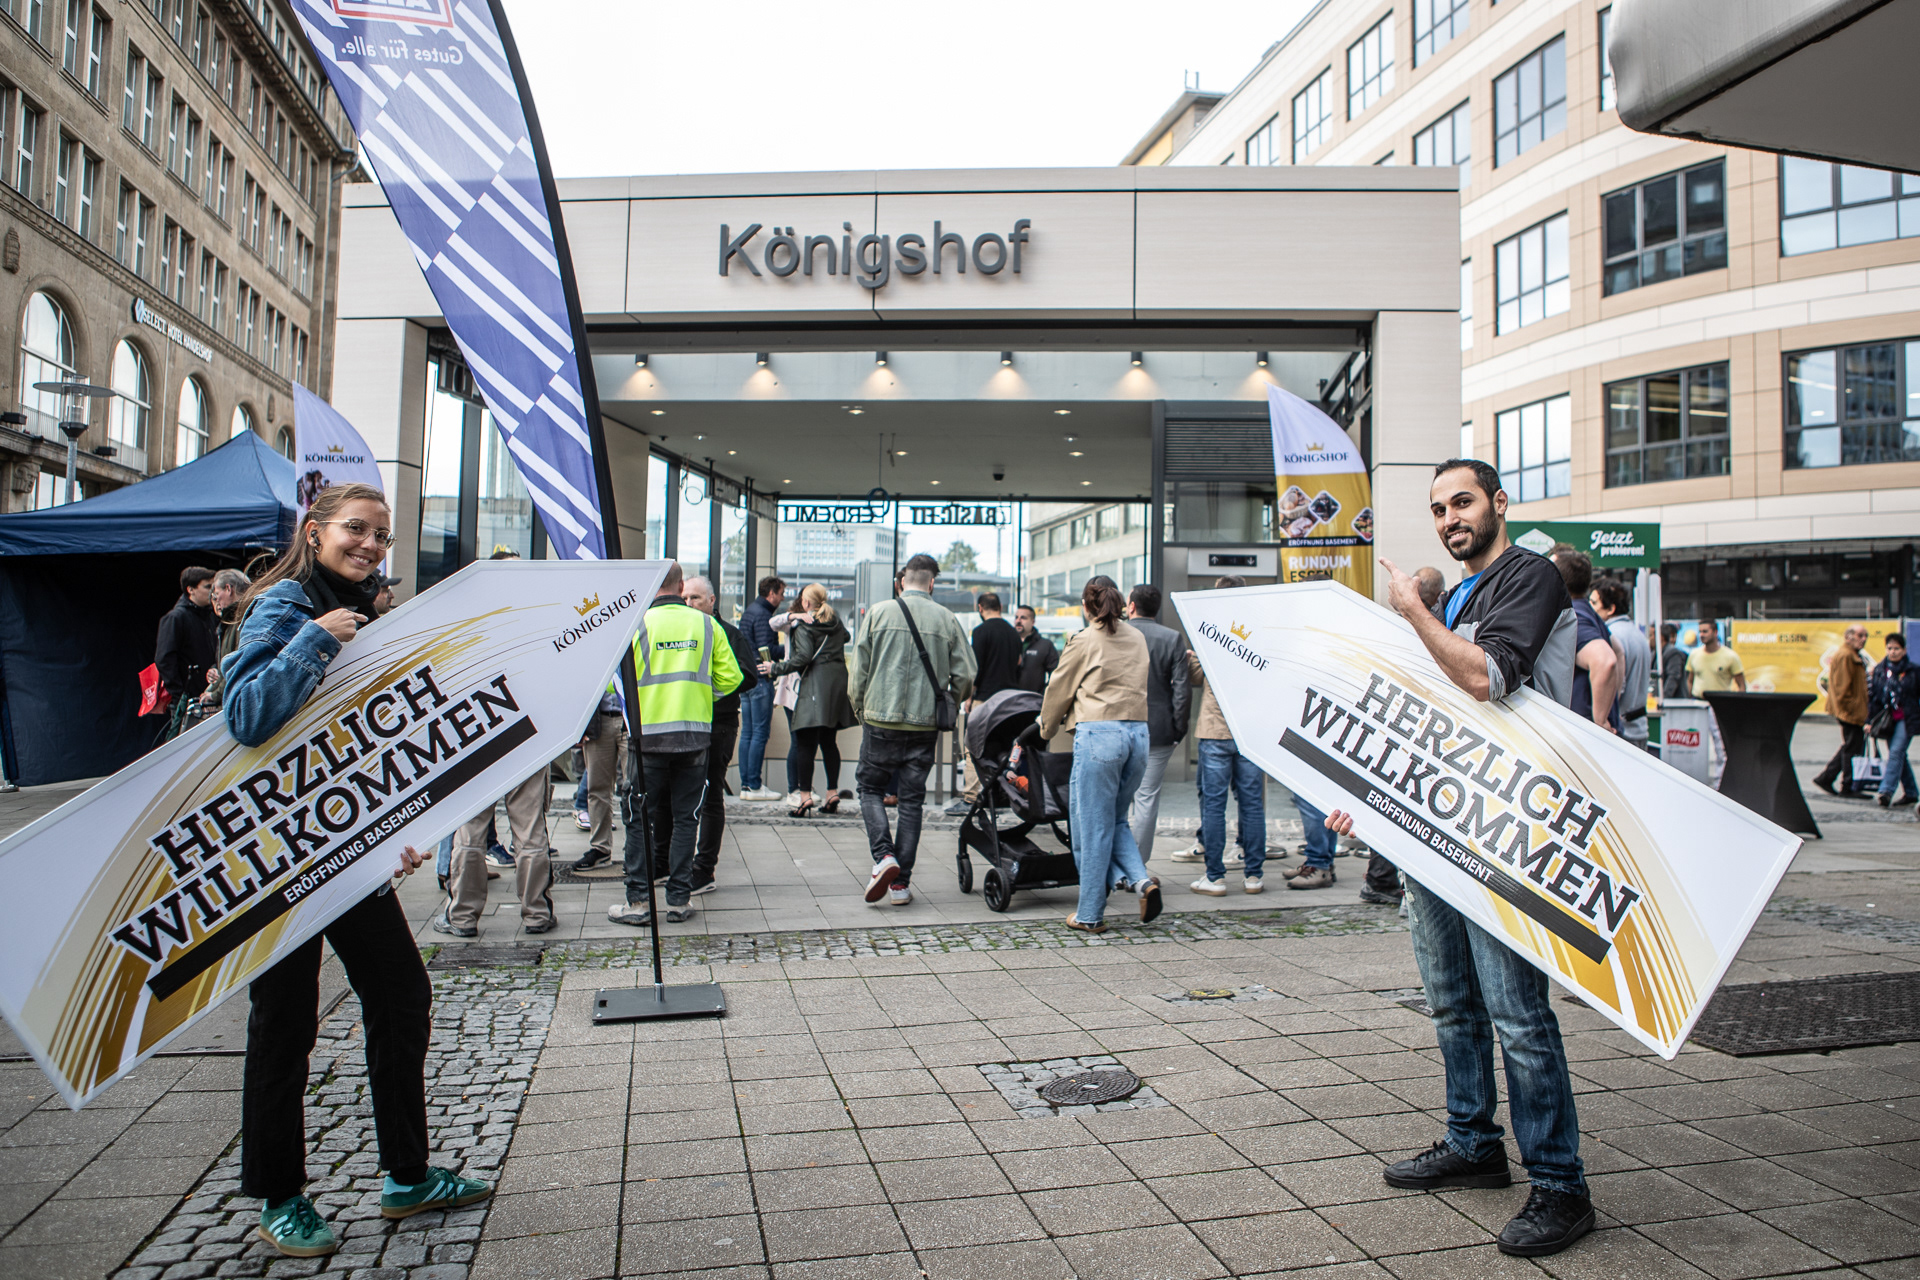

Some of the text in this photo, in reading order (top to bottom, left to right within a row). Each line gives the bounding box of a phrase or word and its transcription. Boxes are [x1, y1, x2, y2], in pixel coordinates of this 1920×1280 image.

[718, 218, 1031, 289] Königshof
[142, 307, 167, 335] SELECT
[304, 452, 366, 464] KÖNIGSHOF
[1284, 452, 1349, 464] KÖNIGSHOF
[1288, 555, 1352, 570] RUNDUM
[1590, 530, 1634, 550] Jetzt
[1601, 545, 1645, 558] probieren!
[552, 589, 637, 653] KÖNIGSHOF
[1198, 621, 1270, 671] KÖNIGSHOF
[153, 665, 450, 880] HERZLICH
[1355, 672, 1607, 850] HERZLICH
[112, 674, 520, 963] WILLKOMMEN
[1300, 687, 1640, 933] WILLKOMMEN
[1366, 789, 1495, 882] ERÖFFNUNG BASEMENT
[283, 791, 432, 903] ERÖFFNUNG BASEMENT
